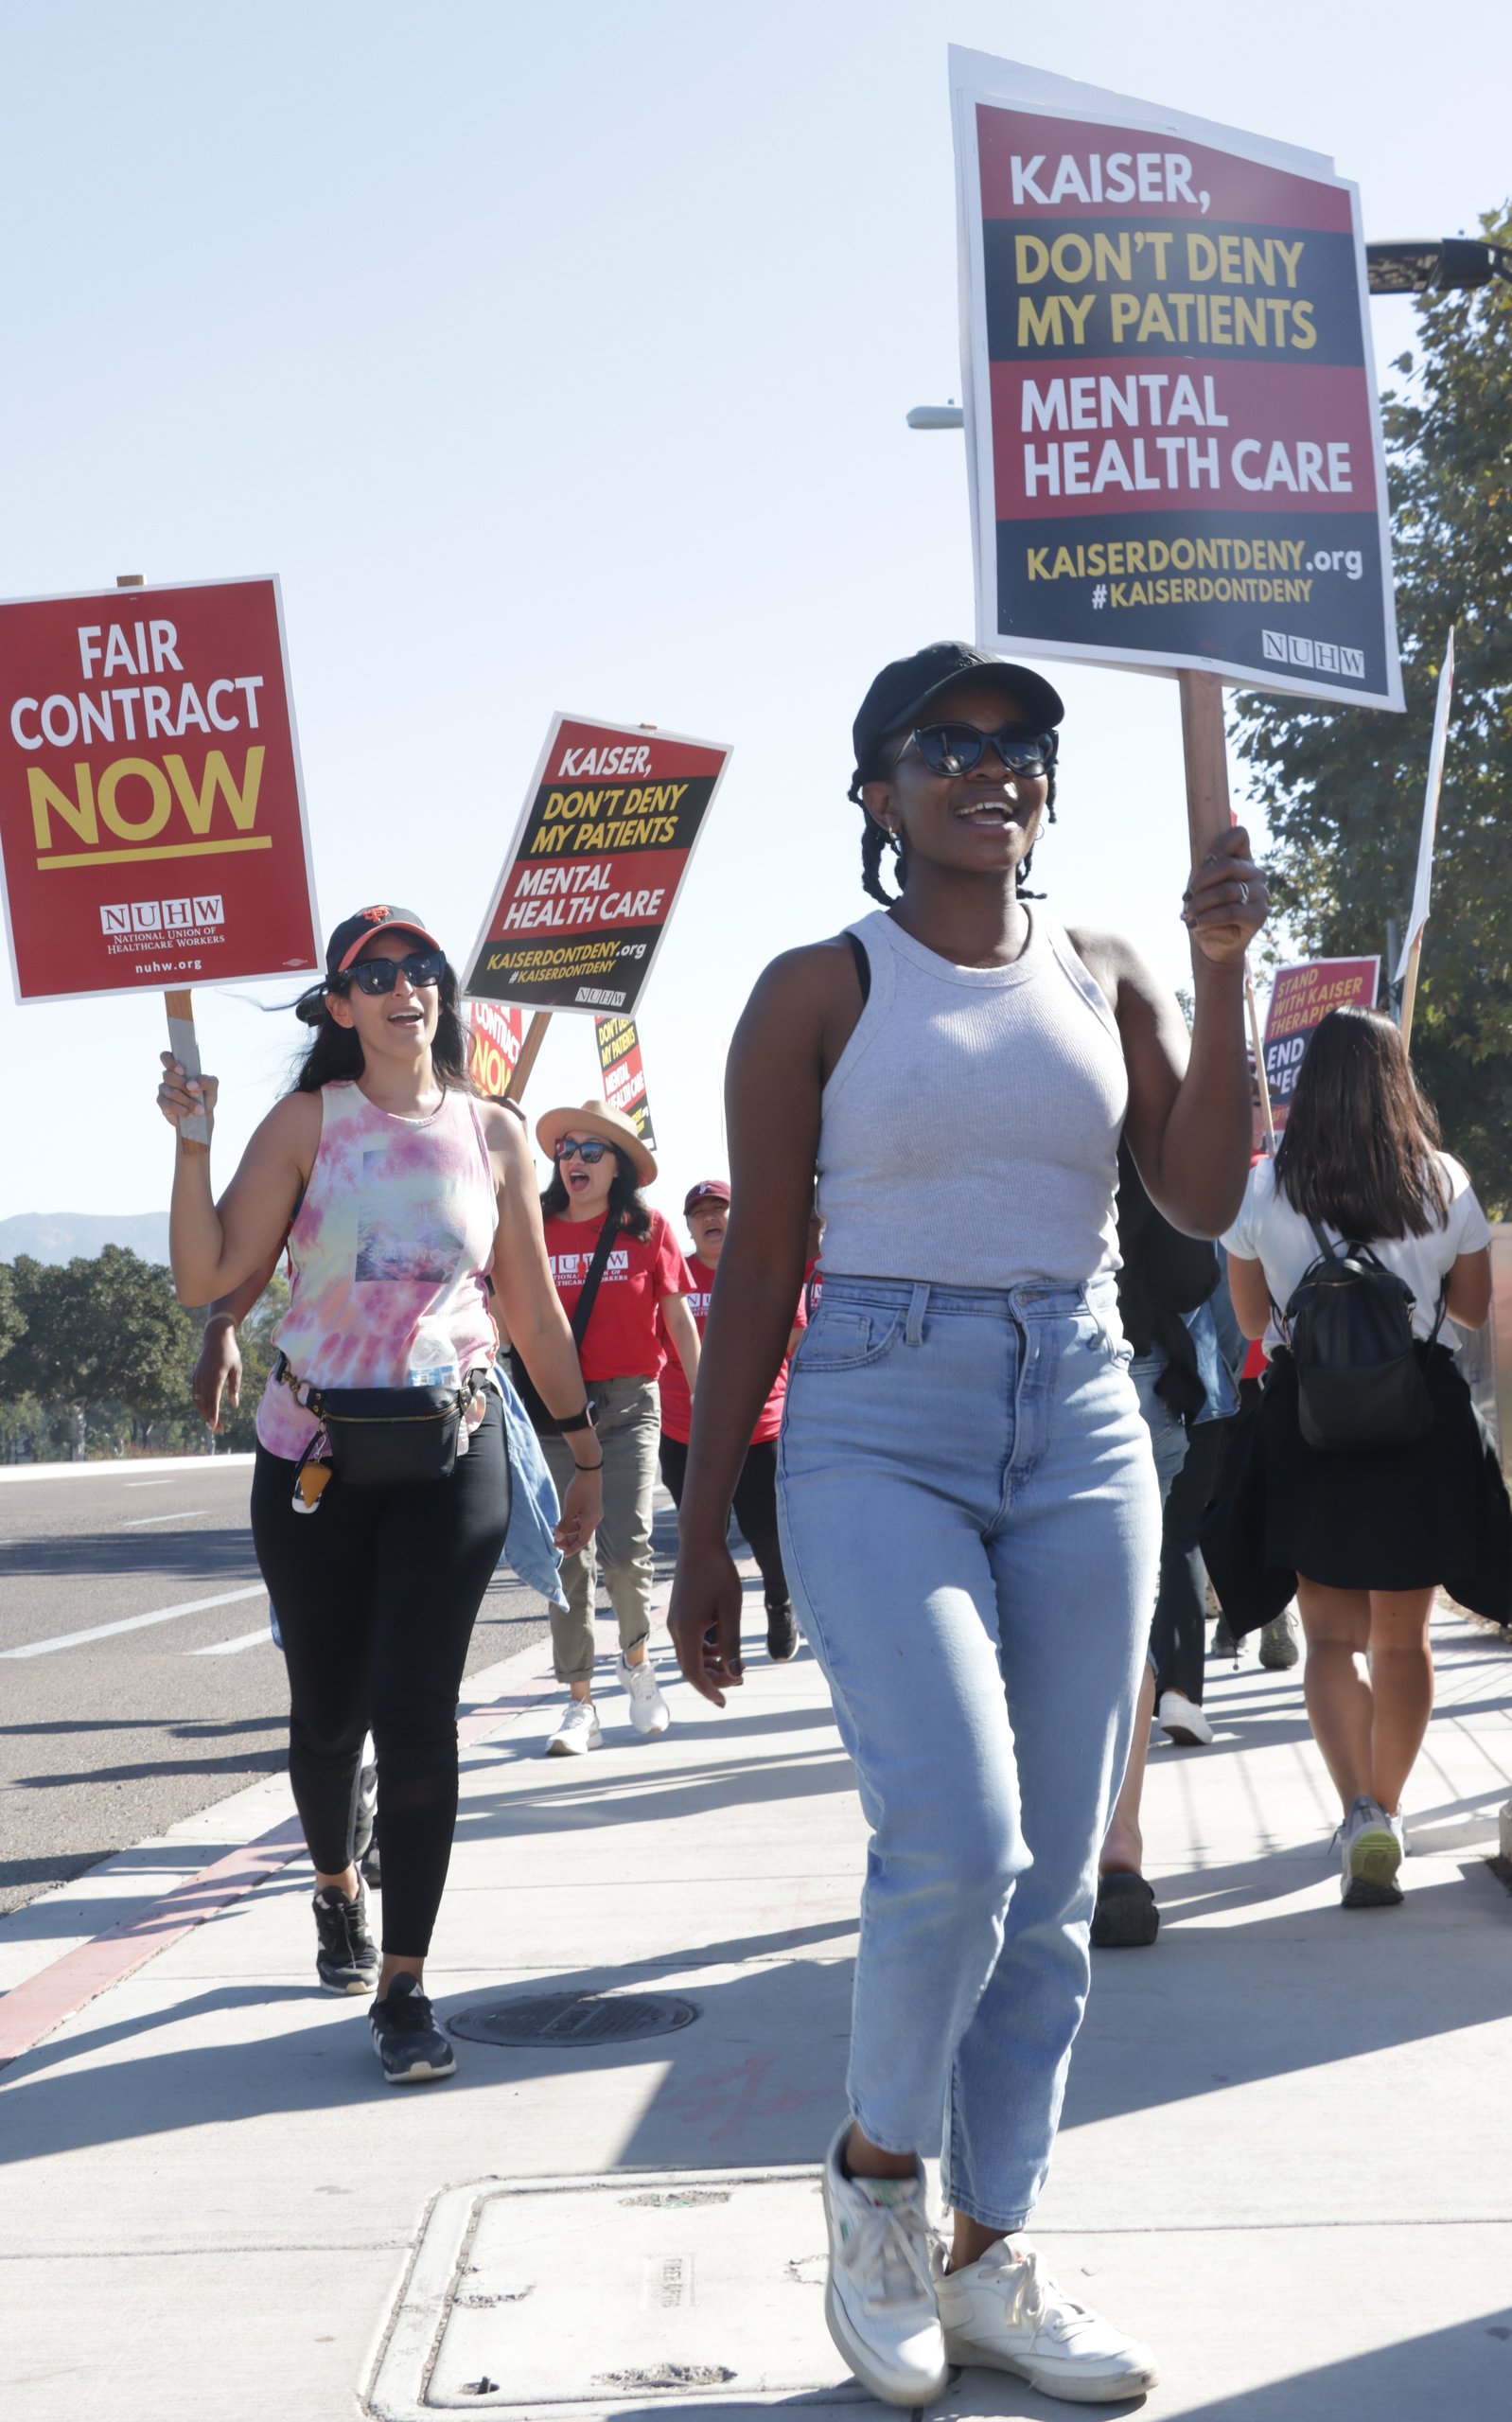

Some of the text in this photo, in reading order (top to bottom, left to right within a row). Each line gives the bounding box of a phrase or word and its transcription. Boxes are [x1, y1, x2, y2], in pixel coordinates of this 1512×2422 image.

[1011, 153, 1210, 214] KAISER,
[1016, 231, 1305, 288] DON'T DENY
[1018, 292, 1317, 350] MY PATIENTS
[1021, 374, 1228, 433] MENTAL
[1025, 437, 1353, 497] HEALTH CARE
[1027, 538, 1363, 580] KAISERDONTDENY.org
[1092, 577, 1313, 610] #KAISERDONTDENY
[78, 619, 184, 680] FAIR
[1263, 630, 1365, 679] NUHW
[10, 676, 263, 750] CONTRACT
[558, 745, 652, 778] KAISER,
[26, 746, 265, 850] NOW
[543, 784, 689, 821] DON'T DENY
[530, 816, 678, 854] MY PATIENTS
[514, 863, 612, 897] MENTAL
[102, 896, 223, 933] NUHW
[502, 889, 665, 930] HEALTH CARE
[135, 960, 202, 974] nuhw.org
[487, 941, 646, 971] KAISERDONTDENY.org
[509, 961, 616, 983] #KAISERDONTDENY
[574, 987, 627, 1008] NUHW
[1275, 976, 1363, 1018] WITH KAISER
[1278, 968, 1318, 999] STAND
[1267, 1037, 1305, 1070] END
